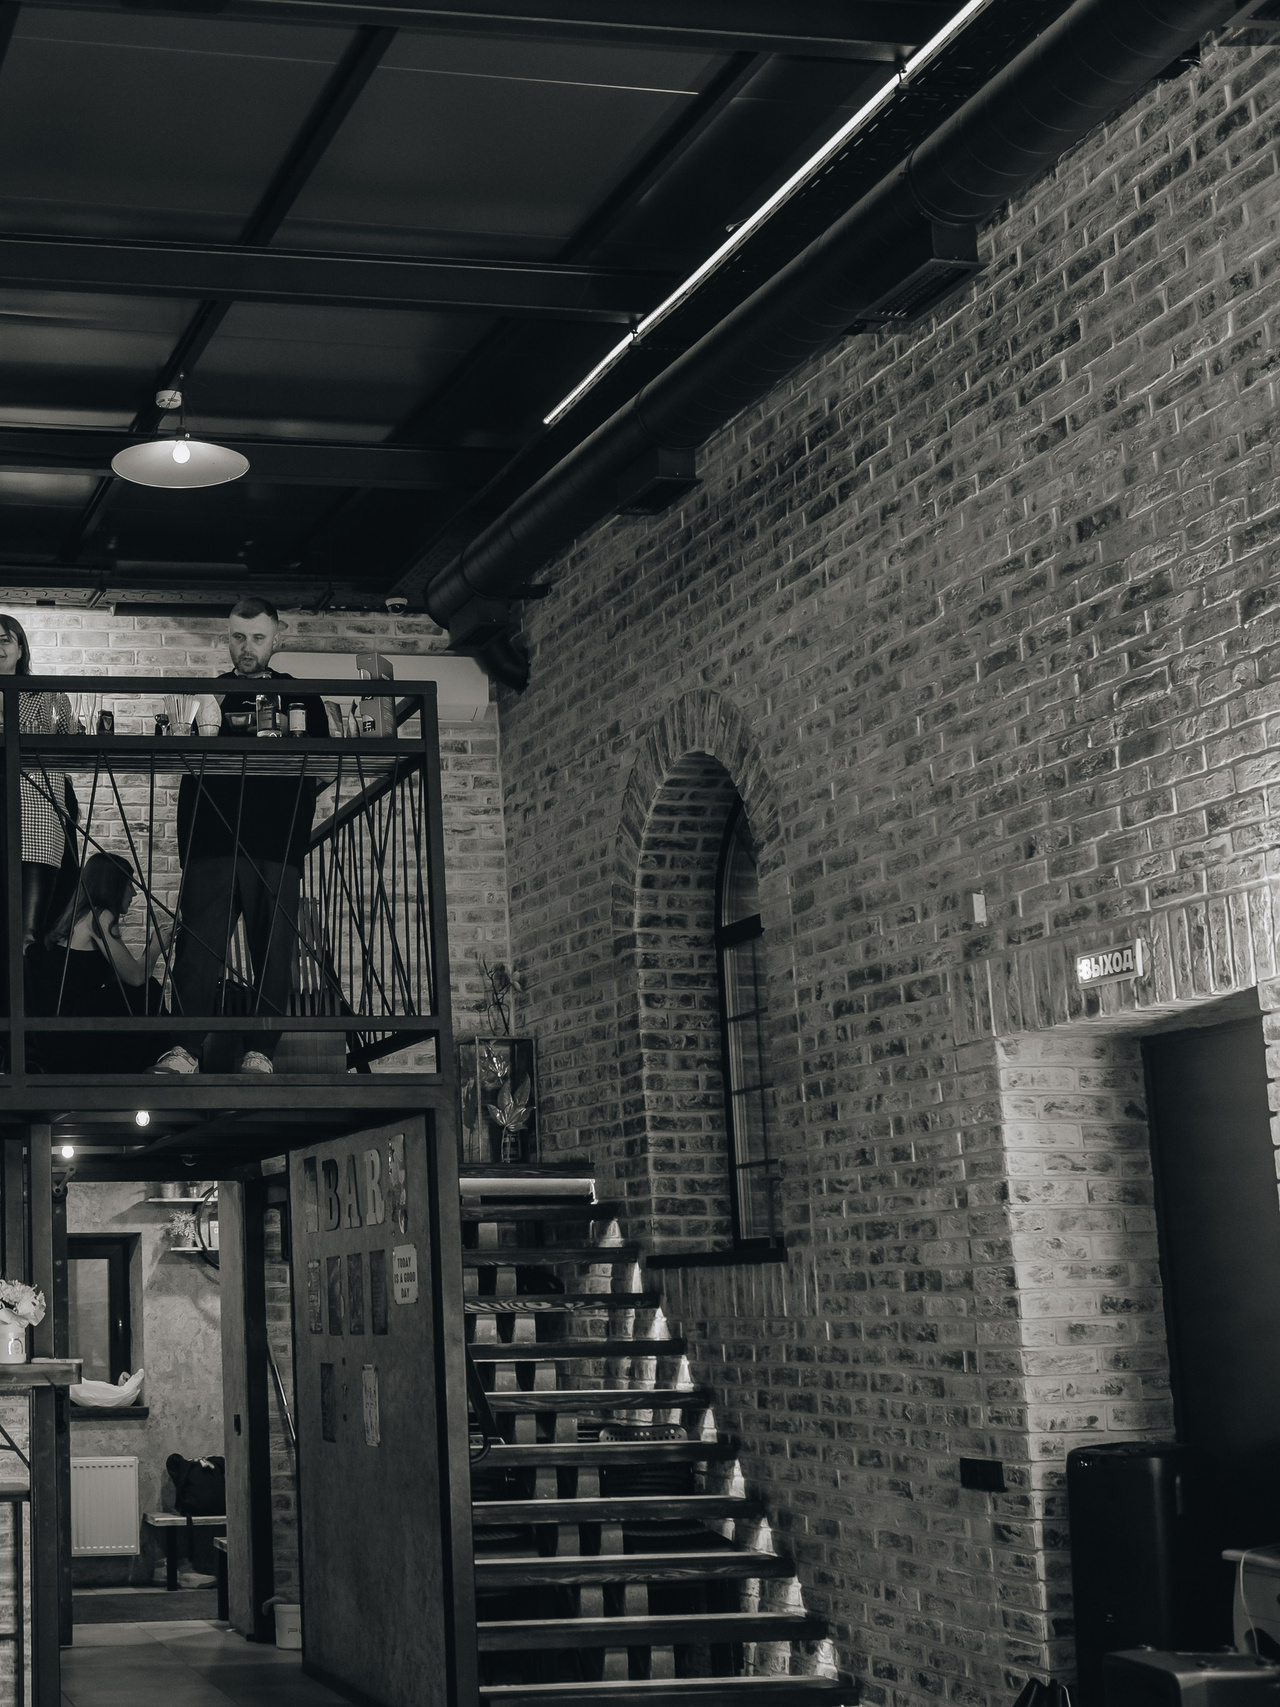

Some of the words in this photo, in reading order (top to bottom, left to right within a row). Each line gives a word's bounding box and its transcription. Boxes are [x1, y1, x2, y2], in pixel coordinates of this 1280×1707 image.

[1081, 949, 1134, 980] ВЫХОД
[322, 1149, 385, 1232] BAR
[397, 1256, 411, 1269] TODAY
[404, 1271, 416, 1283] GOOD
[401, 1287, 410, 1299] DAY
